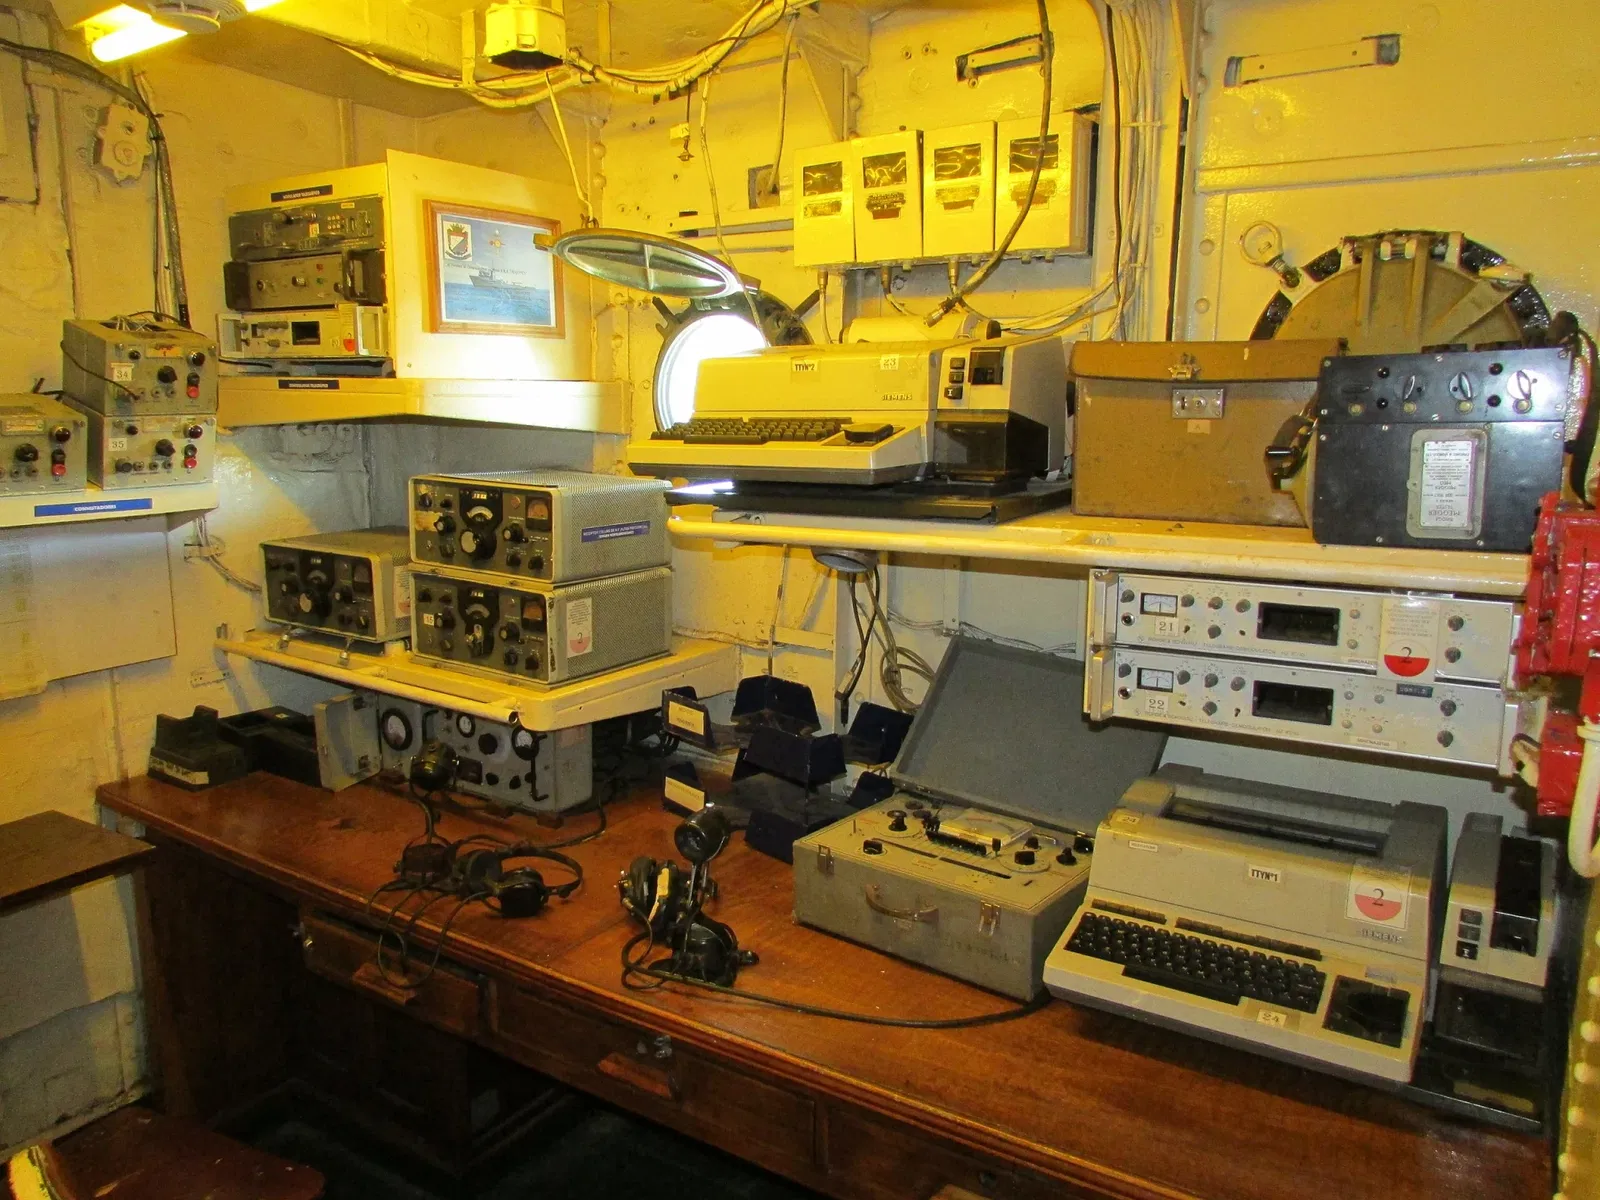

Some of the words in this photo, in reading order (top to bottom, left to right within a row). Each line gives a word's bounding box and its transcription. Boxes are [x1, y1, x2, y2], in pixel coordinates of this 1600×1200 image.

[883, 358, 896, 366] 23
[116, 370, 129, 379] 34
[112, 441, 125, 449] 35
[1159, 622, 1174, 632] 21
[576, 632, 584, 645] 2
[1148, 698, 1165, 710] 22
[1372, 888, 1384, 906] 2
